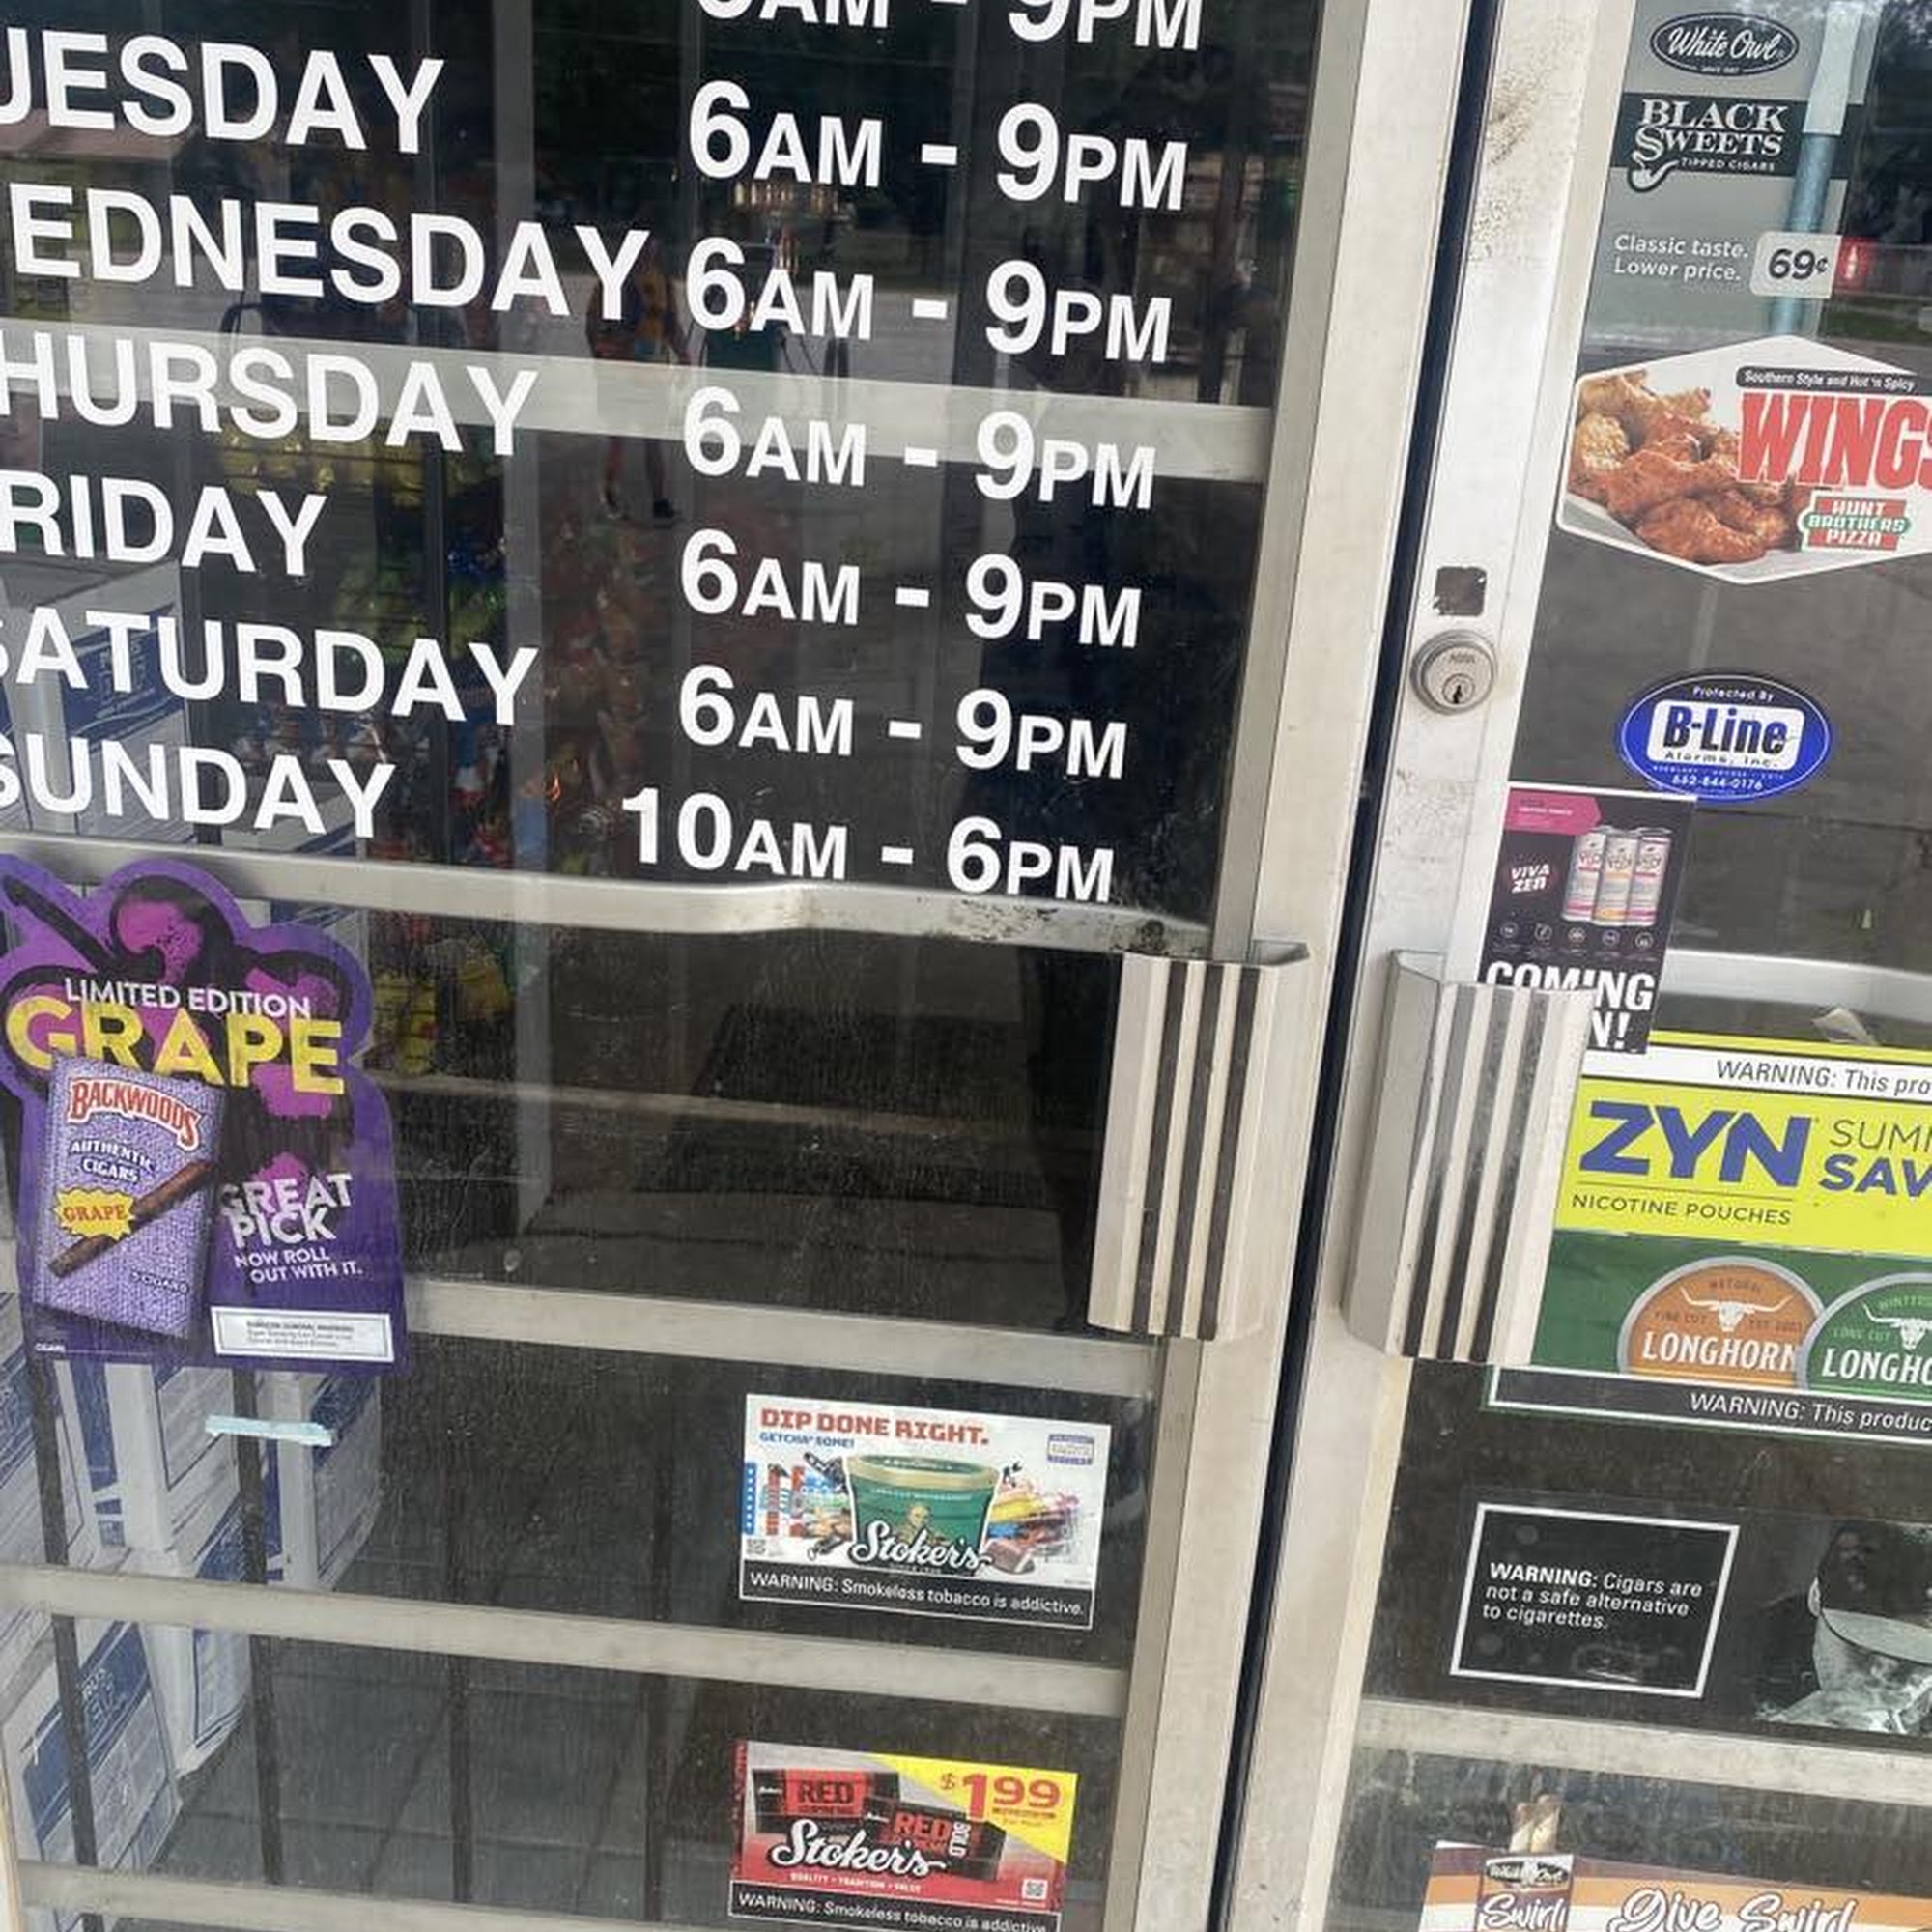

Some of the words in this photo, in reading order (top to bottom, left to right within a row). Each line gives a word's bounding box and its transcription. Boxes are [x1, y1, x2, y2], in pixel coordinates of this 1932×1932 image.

[1668, 26, 1728, 58] White
[1730, 29, 1782, 60] Owl
[1639, 99, 1788, 133] BLACK
[690, 80, 883, 187] 6AM
[997, 102, 1188, 211] 9PM
[1632, 126, 1784, 162] SWEETS
[1681, 156, 1725, 169] TIPPED
[1728, 159, 1776, 172] CIGARS
[1614, 234, 1686, 255] Classic
[1692, 240, 1748, 259] taste.
[10, 183, 650, 321] EDNESDAY
[686, 237, 875, 340] 6AM
[985, 260, 1172, 363] 9PM
[1613, 257, 1679, 276] Lower
[1684, 262, 1741, 282] price.
[1744, 370, 1794, 384] Southern
[1796, 372, 1824, 387] Style
[1827, 374, 1848, 386] and
[1849, 376, 1871, 387] Hot
[1883, 378, 1915, 392] Spicy
[0, 329, 538, 456] HURSDAY
[683, 385, 867, 487] 6AM
[976, 410, 1157, 509] 9PM
[1807, 514, 1906, 533] BROTHERS
[1832, 498, 1885, 516] HUNT
[1825, 529, 1882, 546] PIZZA
[0, 469, 327, 577] RIDAY
[681, 528, 860, 625] 6AM
[965, 554, 1141, 648] 9PM
[0, 606, 539, 725] ATURDAY
[679, 665, 854, 755] 6AM
[956, 689, 1127, 779] 9PM
[1692, 685, 1756, 700] Protected
[1758, 690, 1775, 703] By
[1662, 705, 1787, 755] B-Line
[622, 787, 847, 880] 10AM
[946, 816, 1114, 903] 6PM
[1511, 864, 1550, 880] VIVA
[64, 977, 181, 1010] LIMITED
[187, 988, 311, 1019] EDITION
[5, 994, 345, 1095] GRAPE
[1716, 1059, 1837, 1088] WARNING:
[1845, 1068, 1889, 1092] This
[68, 1079, 201, 1150] BACKWOODS
[70, 1139, 156, 1171] AUTHENTIC
[1579, 1100, 1813, 1188] ZYN
[82, 1158, 140, 1183] CIGARS
[219, 1172, 354, 1215] GREAT
[1571, 1193, 1679, 1217] NICOTINE
[1685, 1203, 1793, 1226] POUCHES
[62, 1204, 128, 1223] GRAPE
[222, 1203, 337, 1249] PICK
[234, 1250, 279, 1268] NOW
[284, 1246, 330, 1264] ROLL
[249, 1267, 287, 1284] OUT
[290, 1263, 338, 1280] WITH
[342, 1260, 364, 1275] IT.
[1643, 1330, 1797, 1372] LONGHORN
[1690, 1392, 1805, 1421] WARNING:
[1811, 1402, 1855, 1425] This
[760, 1407, 812, 1430] DIP
[816, 1412, 891, 1436] DONE
[895, 1418, 990, 1445] RIGHT.
[851, 1520, 992, 1570] Stoker's
[750, 1571, 839, 1593] WARNING:
[841, 1577, 924, 1603] Smokeless
[927, 1589, 990, 1607] tobacco
[993, 1595, 1007, 1608] is
[1010, 1596, 1084, 1617] addictive.
[1489, 1561, 1598, 1589] WARNING:
[1603, 1571, 1665, 1595] Cigars
[1670, 1581, 1703, 1598] are
[1483, 1604, 1501, 1619] to
[1506, 1605, 1608, 1630] cigarettes.
[1486, 1585, 1518, 1602] not
[1521, 1589, 1533, 1603] a
[1539, 1588, 1581, 1606] safe
[1586, 1592, 1690, 1617] alternative
[798, 1780, 855, 1804] RED
[893, 1811, 952, 1837] RED
[772, 1818, 947, 1877] Stoker's
[738, 1891, 821, 1914] WARNING:
[824, 1900, 902, 1921] Smokeless
[904, 1911, 962, 1928] tobacco
[965, 1916, 979, 1930] is
[1739, 1892, 1859, 1932] Swirl
